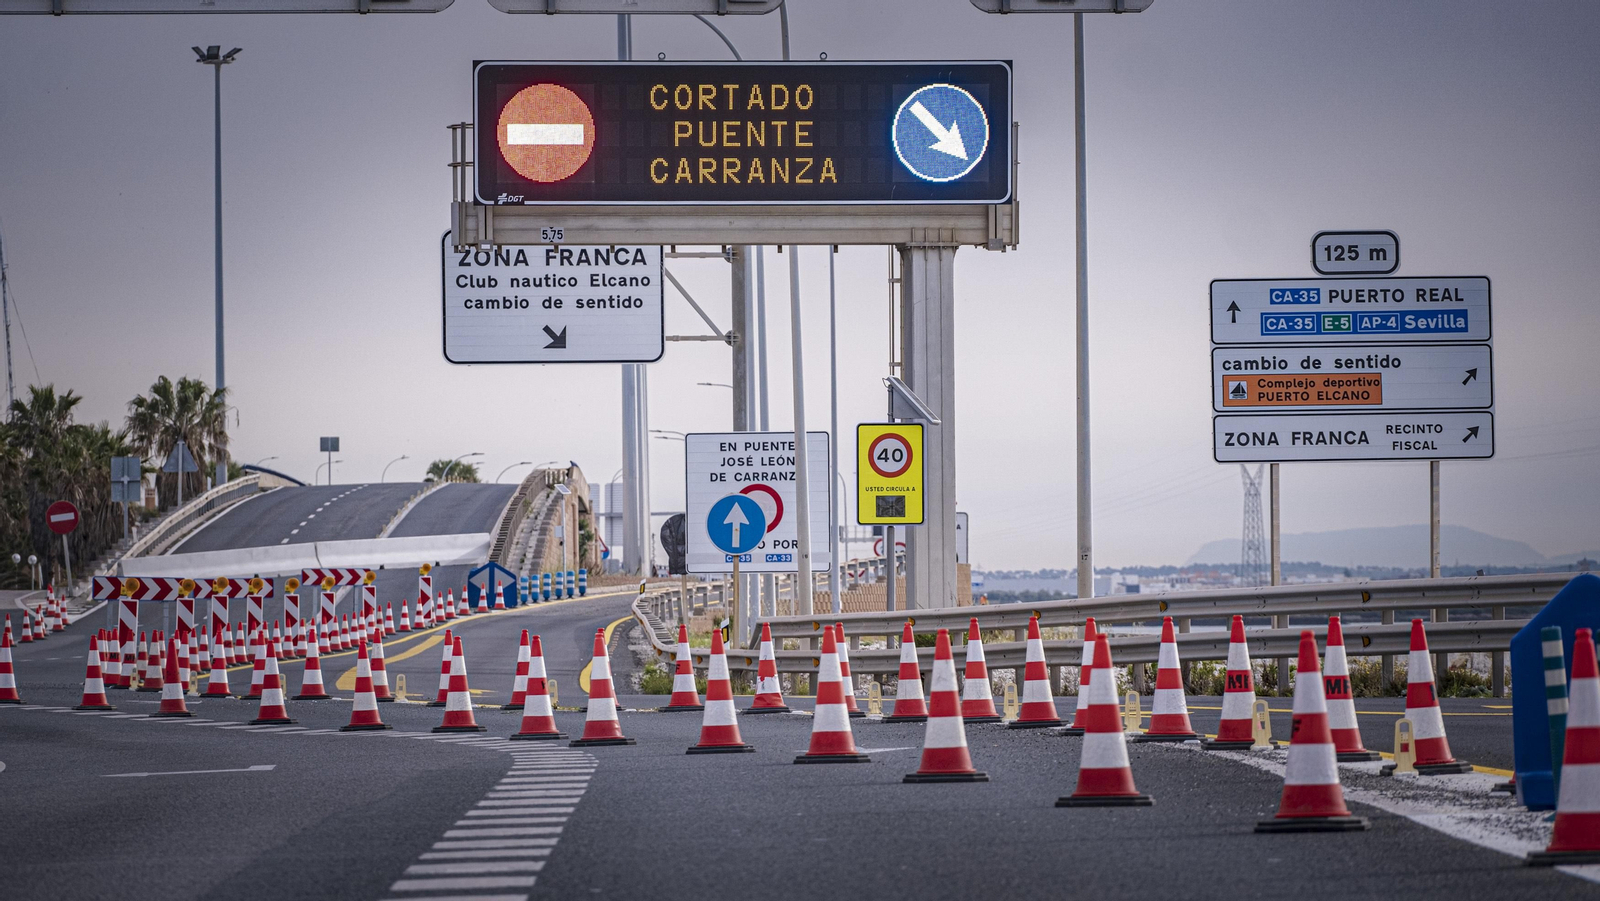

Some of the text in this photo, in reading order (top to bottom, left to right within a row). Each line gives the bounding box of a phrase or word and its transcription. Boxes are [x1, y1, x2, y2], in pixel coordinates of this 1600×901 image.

[650, 84, 814, 110] CORTADO
[674, 120, 814, 146] PUENTE
[650, 158, 838, 184] CARRANZA
[458, 248, 648, 267] ZONA FRANCA
[1324, 244, 1386, 262] 125 m
[456, 274, 650, 288] Club nautico Elcano
[464, 294, 642, 310] cambio de sentido
[1272, 288, 1464, 304] CA-35 PUERTO REAL
[1266, 314, 1466, 330] CA-35 E-5 AP-4 Sevilla
[1222, 354, 1402, 370] cambio de sentido
[1258, 376, 1380, 390] Complejo deportivo
[1258, 390, 1370, 402] PUERTO ELCANO
[1386, 424, 1442, 434] RECINTO
[1224, 430, 1370, 446] ZONA FRANCA
[1392, 440, 1438, 450] FISCAL
[720, 442, 796, 452] EN PUENTE
[720, 454, 796, 466] JOSÉ LEÓN
[876, 448, 904, 463] 40
[710, 472, 796, 482] DE CARRANZ
[774, 540, 798, 550] POR
[726, 554, 752, 562] C-35
